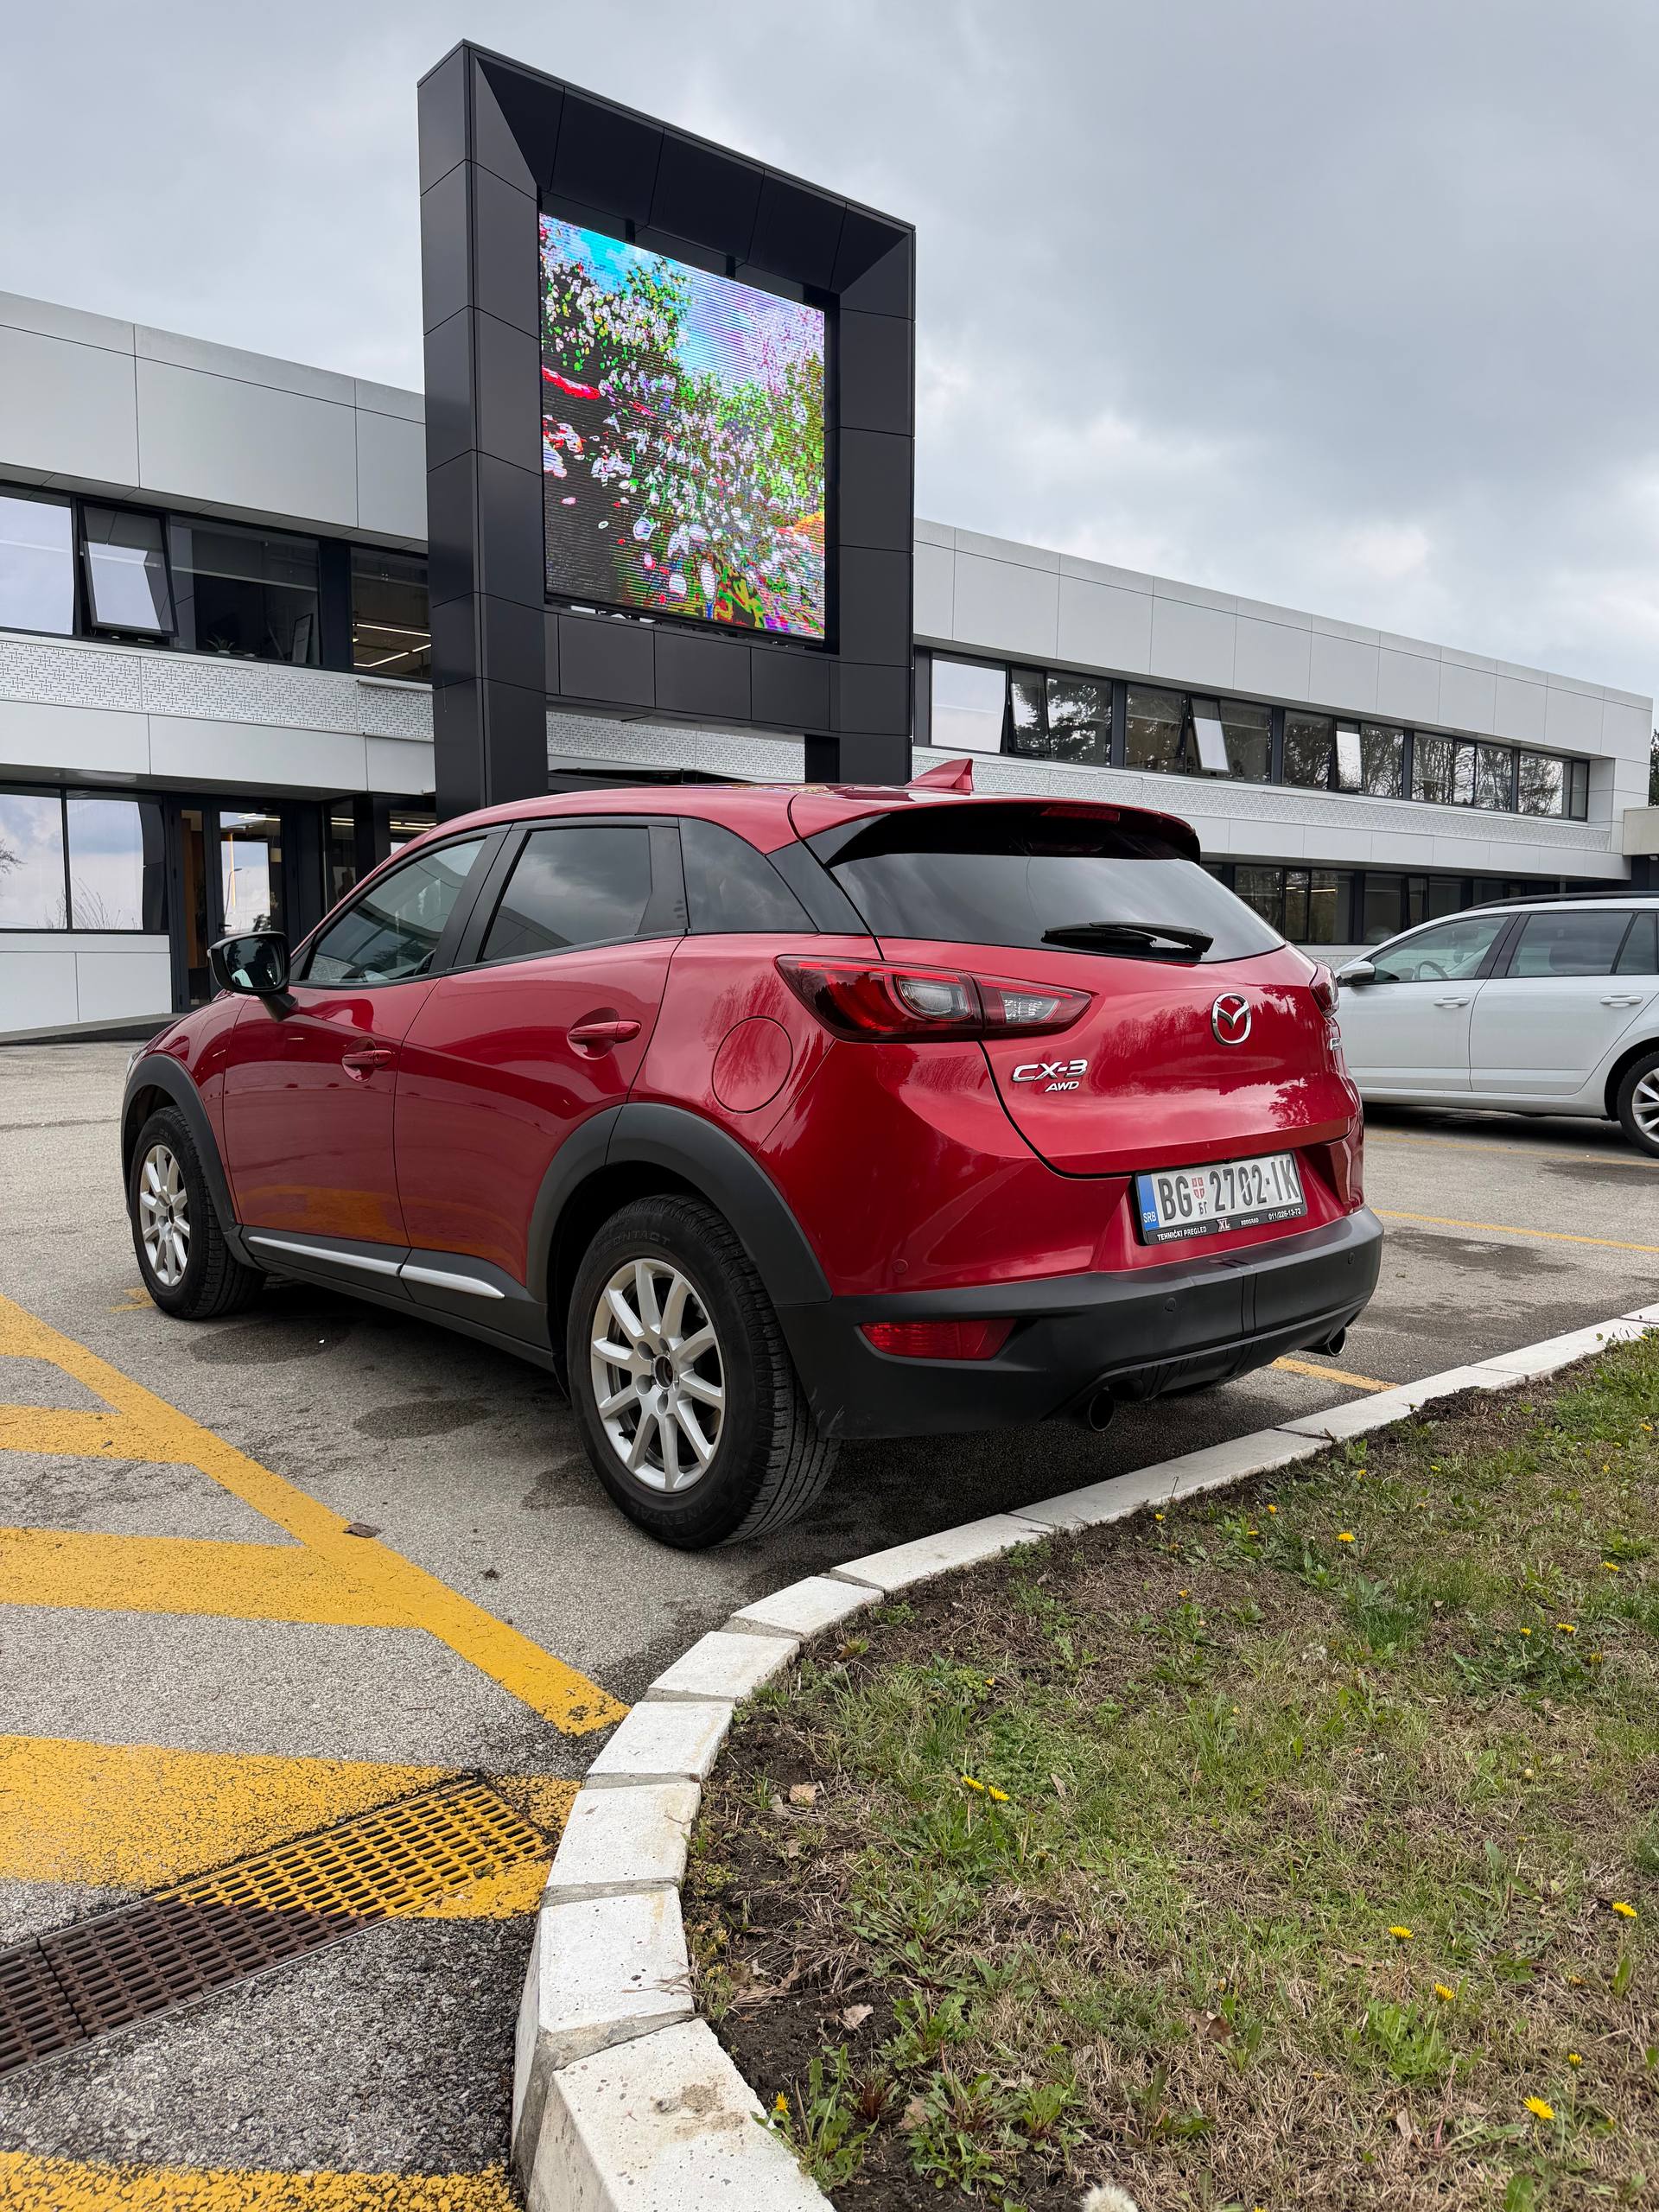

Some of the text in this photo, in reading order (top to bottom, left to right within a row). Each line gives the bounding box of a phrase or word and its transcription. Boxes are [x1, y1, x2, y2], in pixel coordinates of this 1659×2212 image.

[1012, 1059, 1089, 1083] CX-3
[1045, 1081, 1080, 1093] AWD
[1158, 1176, 1192, 1221] BG
[1143, 1211, 1157, 1224] SRB
[1184, 1225, 1207, 1236] PREGLED
